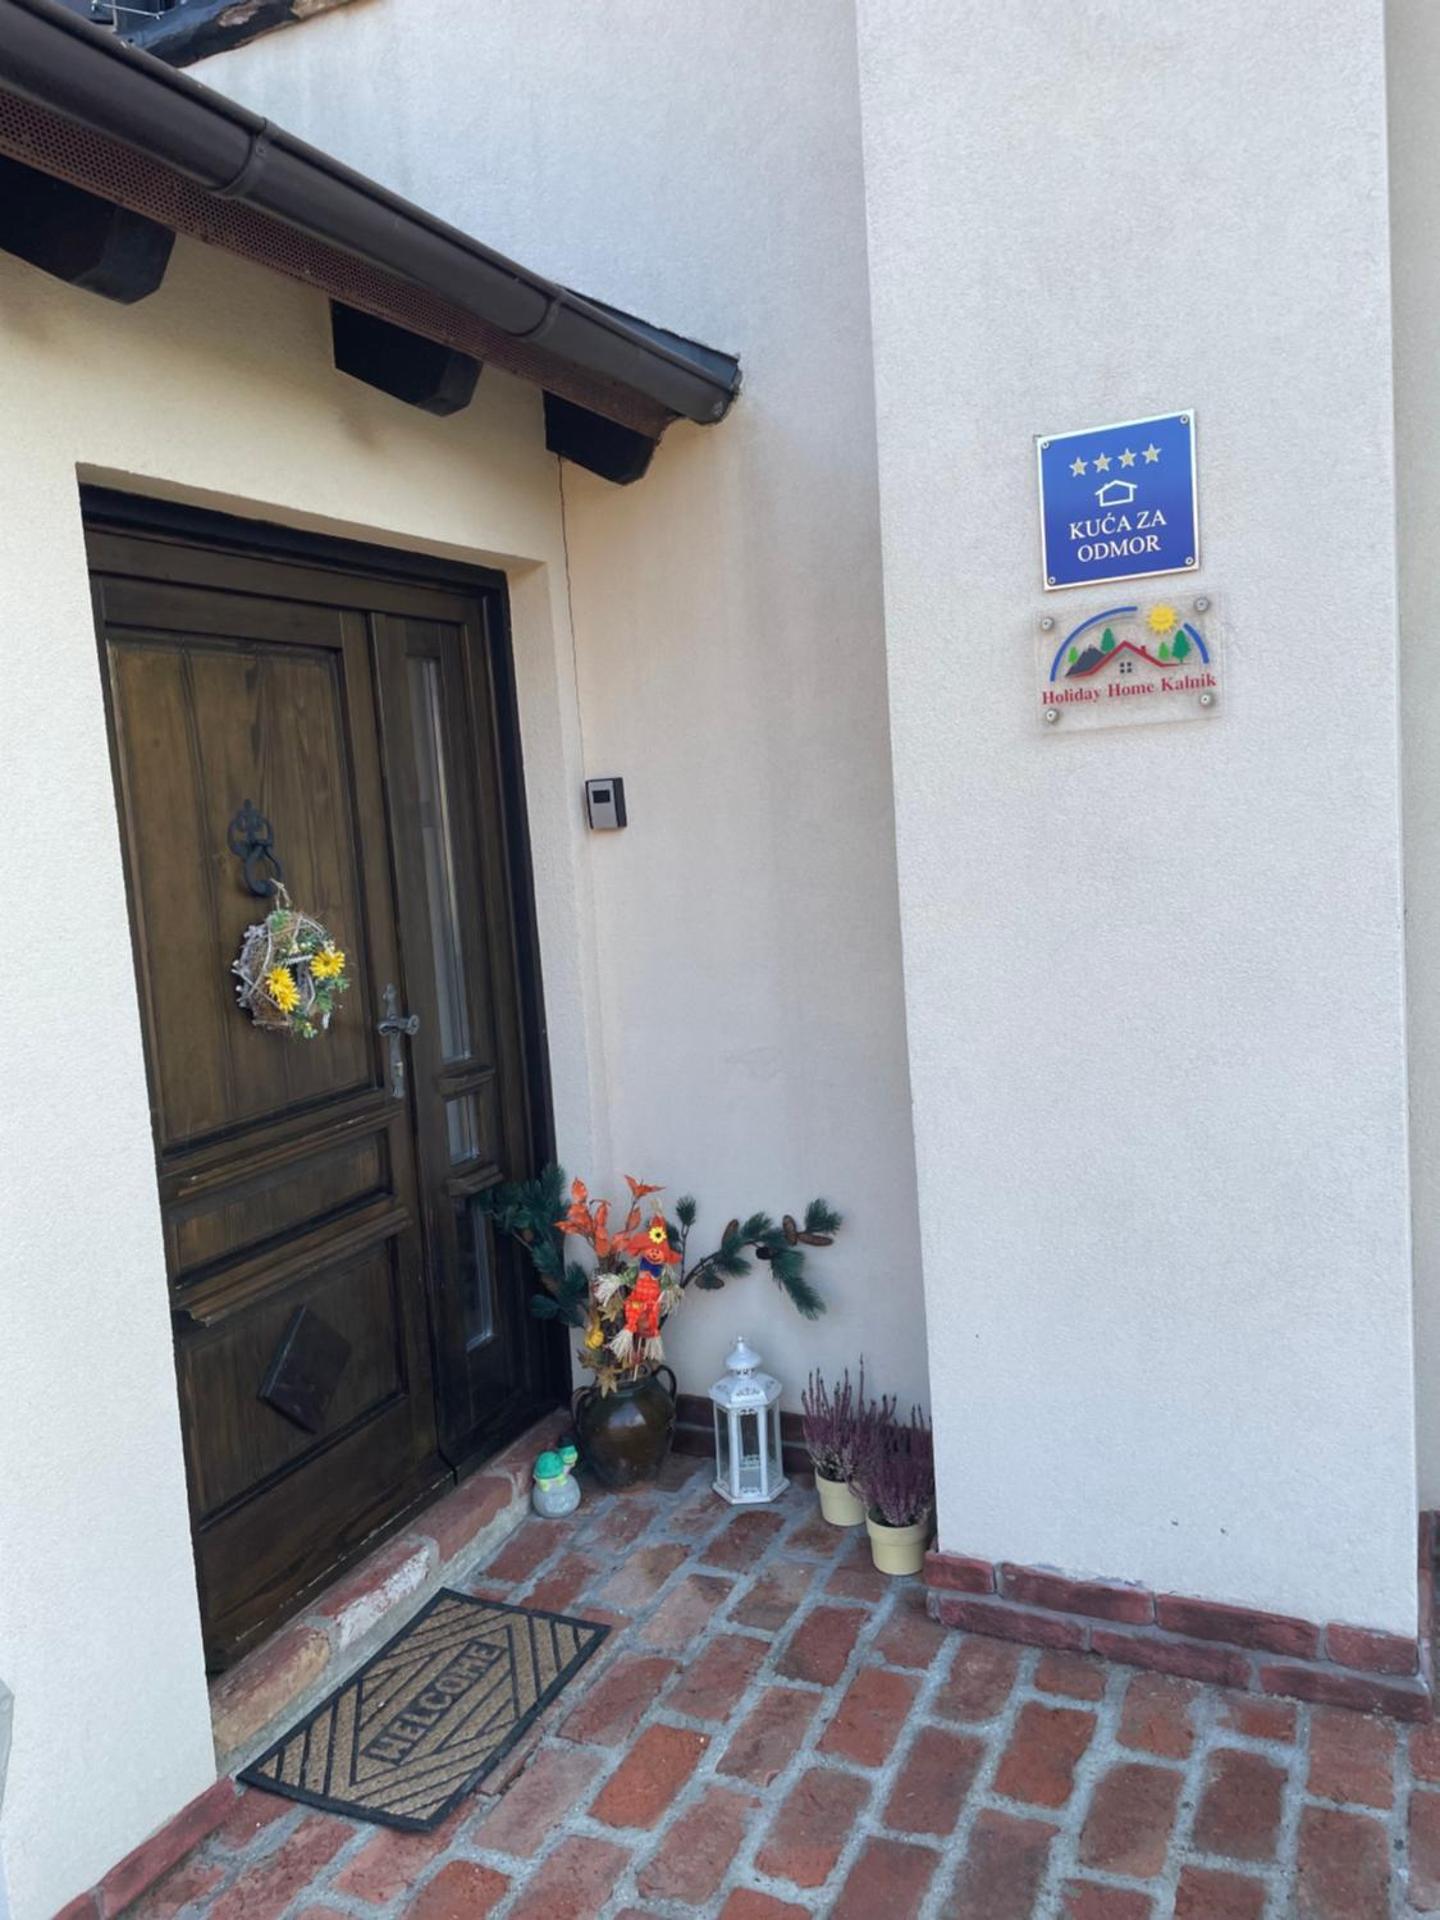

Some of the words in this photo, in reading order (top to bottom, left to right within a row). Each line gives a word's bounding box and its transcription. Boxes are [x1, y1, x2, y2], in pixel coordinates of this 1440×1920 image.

[1069, 512, 1132, 540] KUĆA
[1136, 509, 1167, 530] ZA
[1077, 534, 1161, 563] ODMOR
[1042, 689, 1101, 705] Holiday
[1107, 682, 1155, 698] Home
[1160, 673, 1217, 692] Kalnik
[367, 1640, 502, 1763] WELCOME
